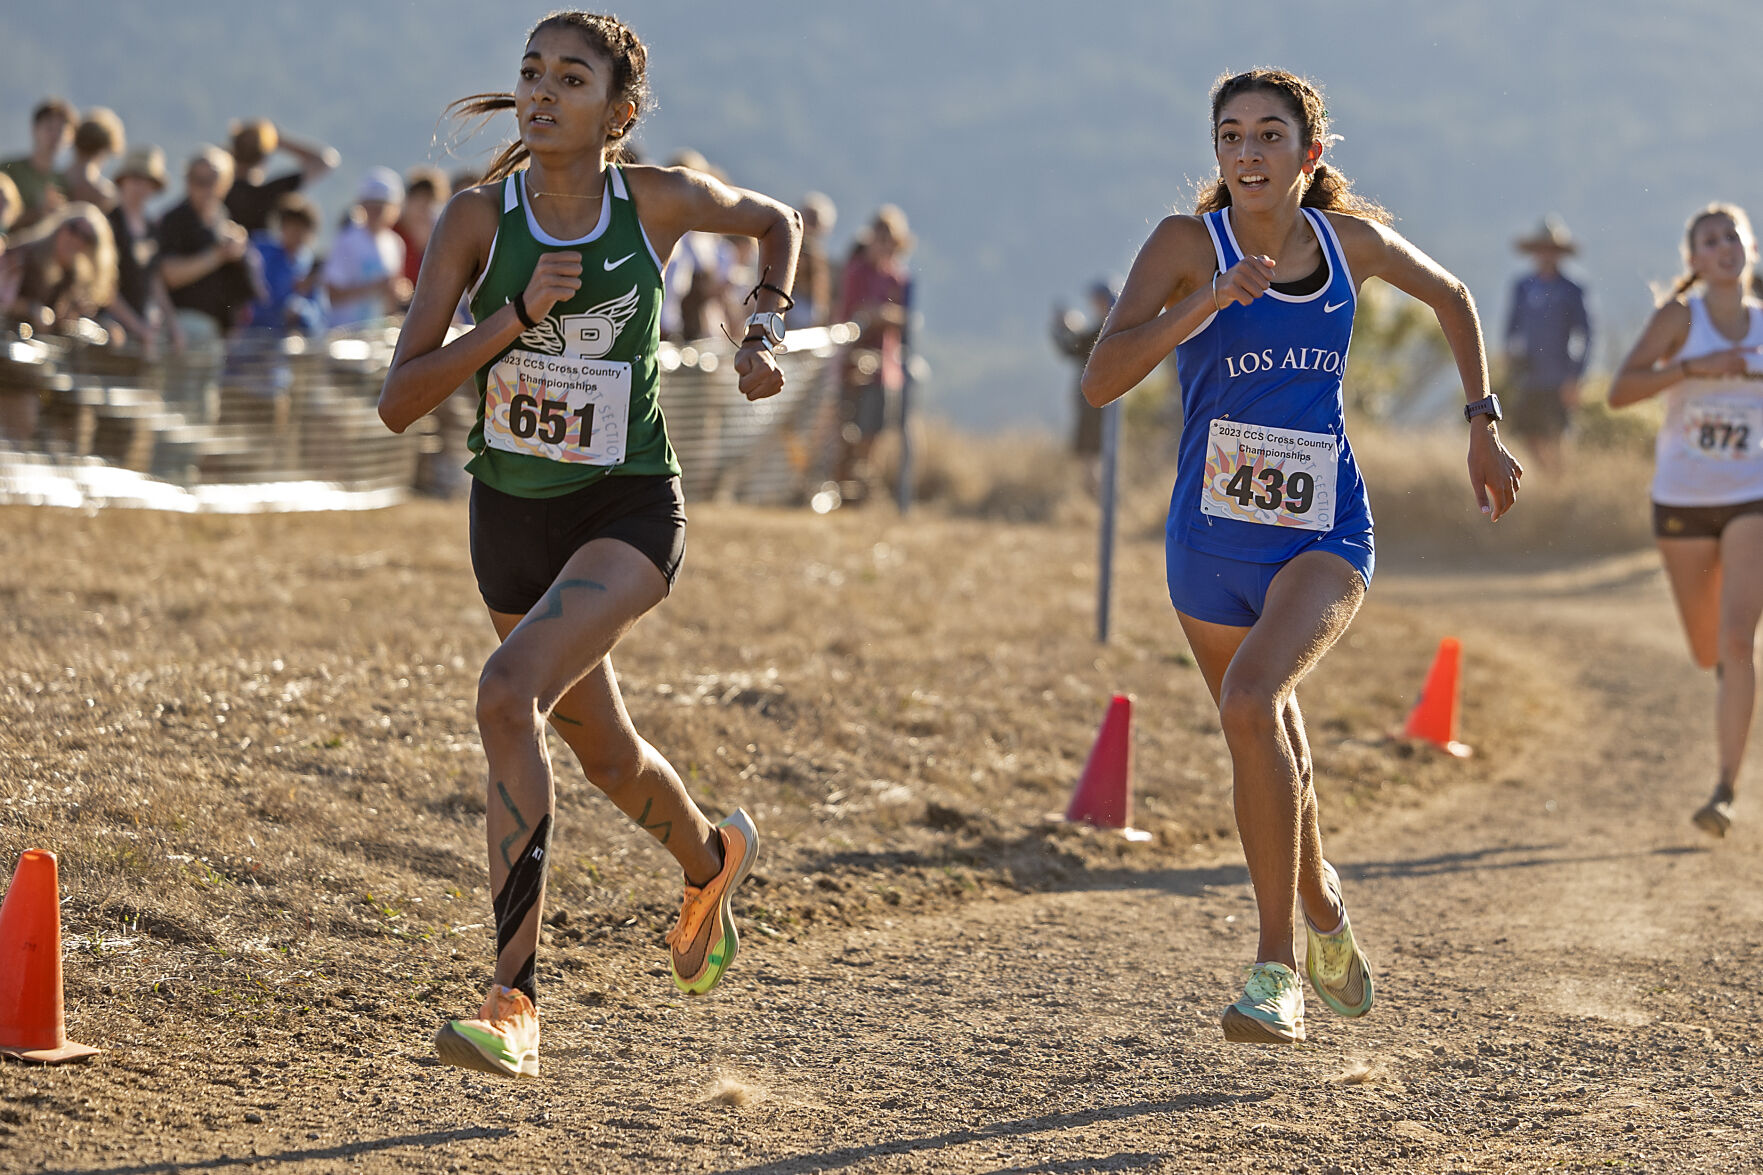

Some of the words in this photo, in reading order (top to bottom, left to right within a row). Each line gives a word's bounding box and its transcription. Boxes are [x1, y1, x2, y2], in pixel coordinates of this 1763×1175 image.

[523, 358, 545, 371] CCS
[547, 362, 579, 375] Cross
[581, 366, 621, 379] Country
[1225, 348, 1274, 378] LOS
[1280, 347, 1347, 376] ALTOS
[519, 372, 598, 392] Championships
[509, 394, 595, 448] 651
[598, 404, 620, 461] SECTIO
[1219, 426, 1241, 438] 2023
[1243, 430, 1264, 441] CCS
[1266, 433, 1295, 445] Cross
[1297, 437, 1334, 451] Country
[1699, 422, 1751, 452] 872
[1239, 443, 1311, 462] Championships
[1225, 464, 1315, 514] 439
